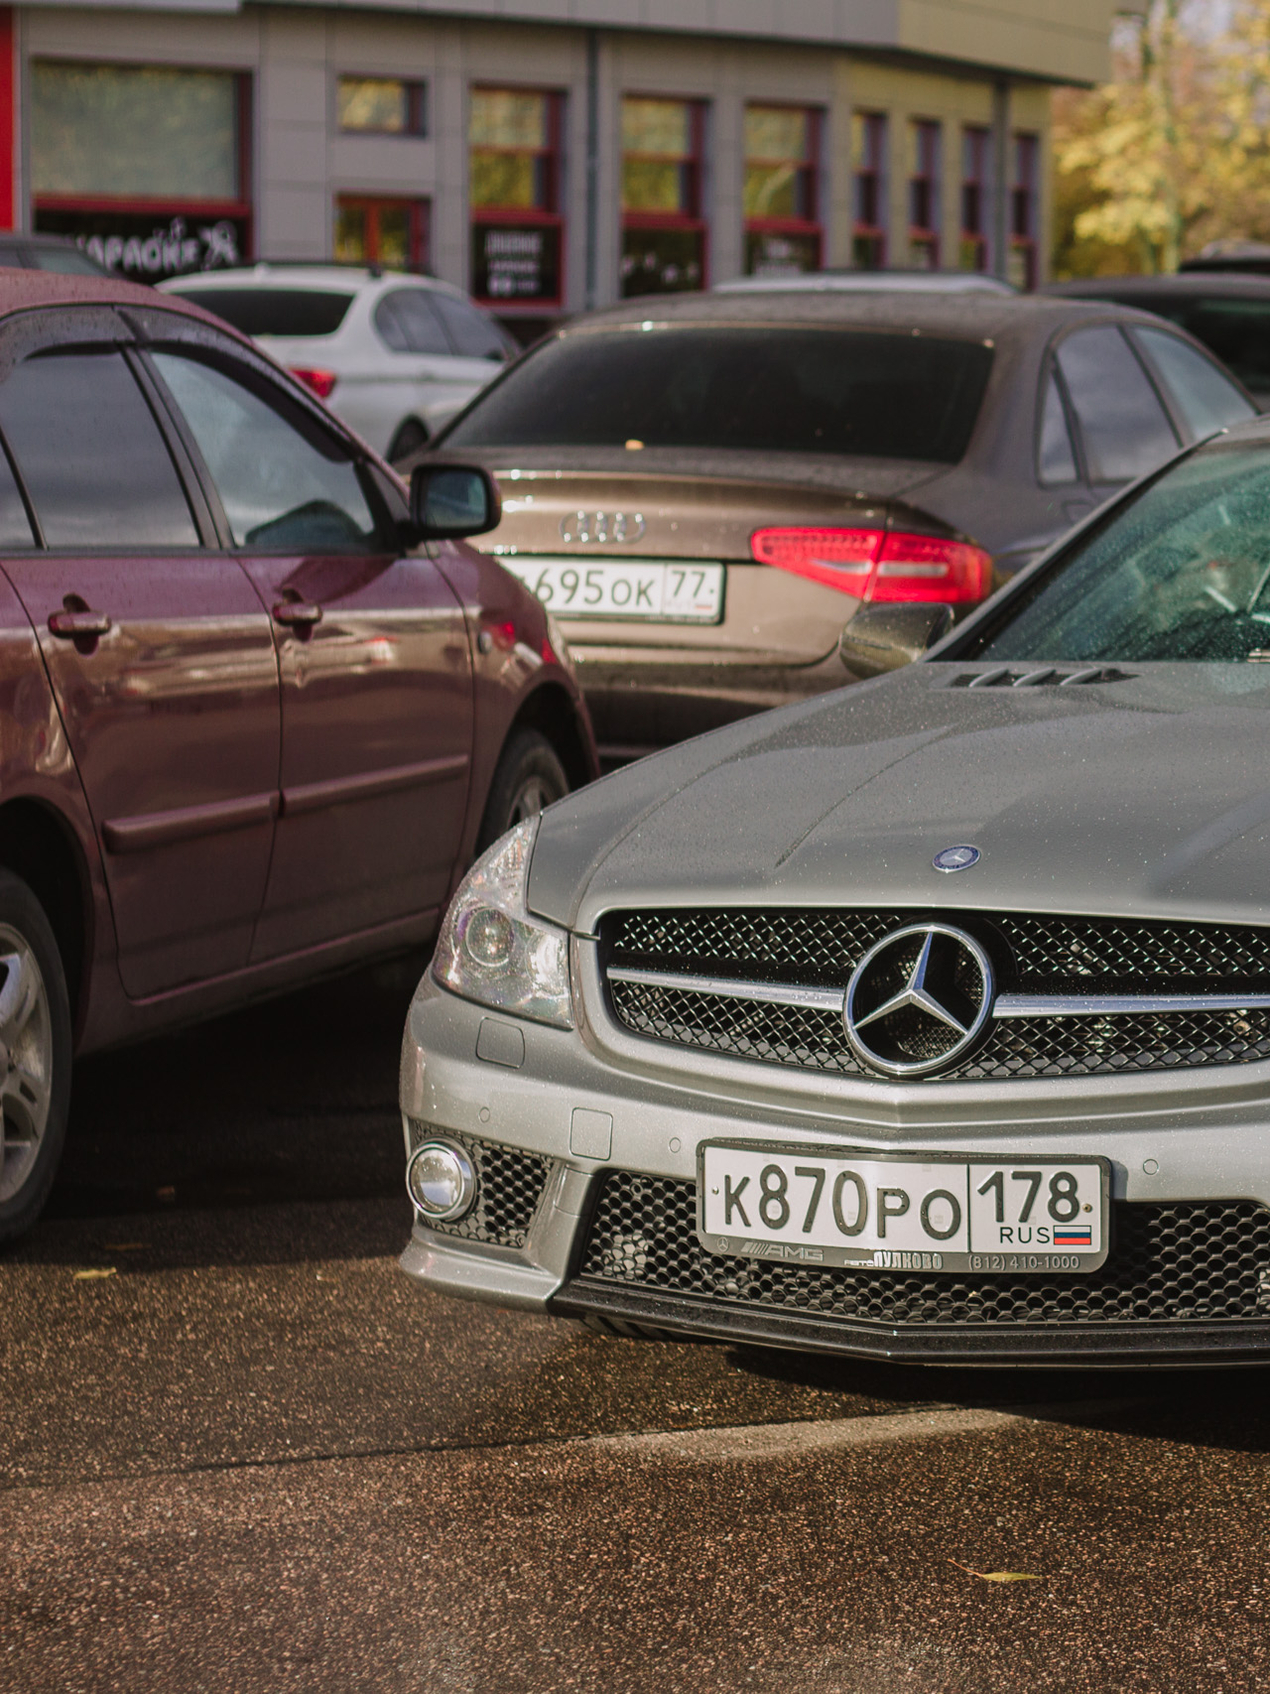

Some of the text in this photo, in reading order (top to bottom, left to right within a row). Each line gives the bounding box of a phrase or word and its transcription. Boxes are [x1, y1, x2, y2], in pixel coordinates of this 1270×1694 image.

[75, 235, 199, 272] АРАОКЕ
[518, 568, 706, 608] 695ОК 77
[724, 1164, 1080, 1240] К870РО 178
[1000, 1226, 1050, 1244] RUS
[765, 1244, 824, 1262] AMG
[968, 1254, 1080, 1271] (812) 410-1000
